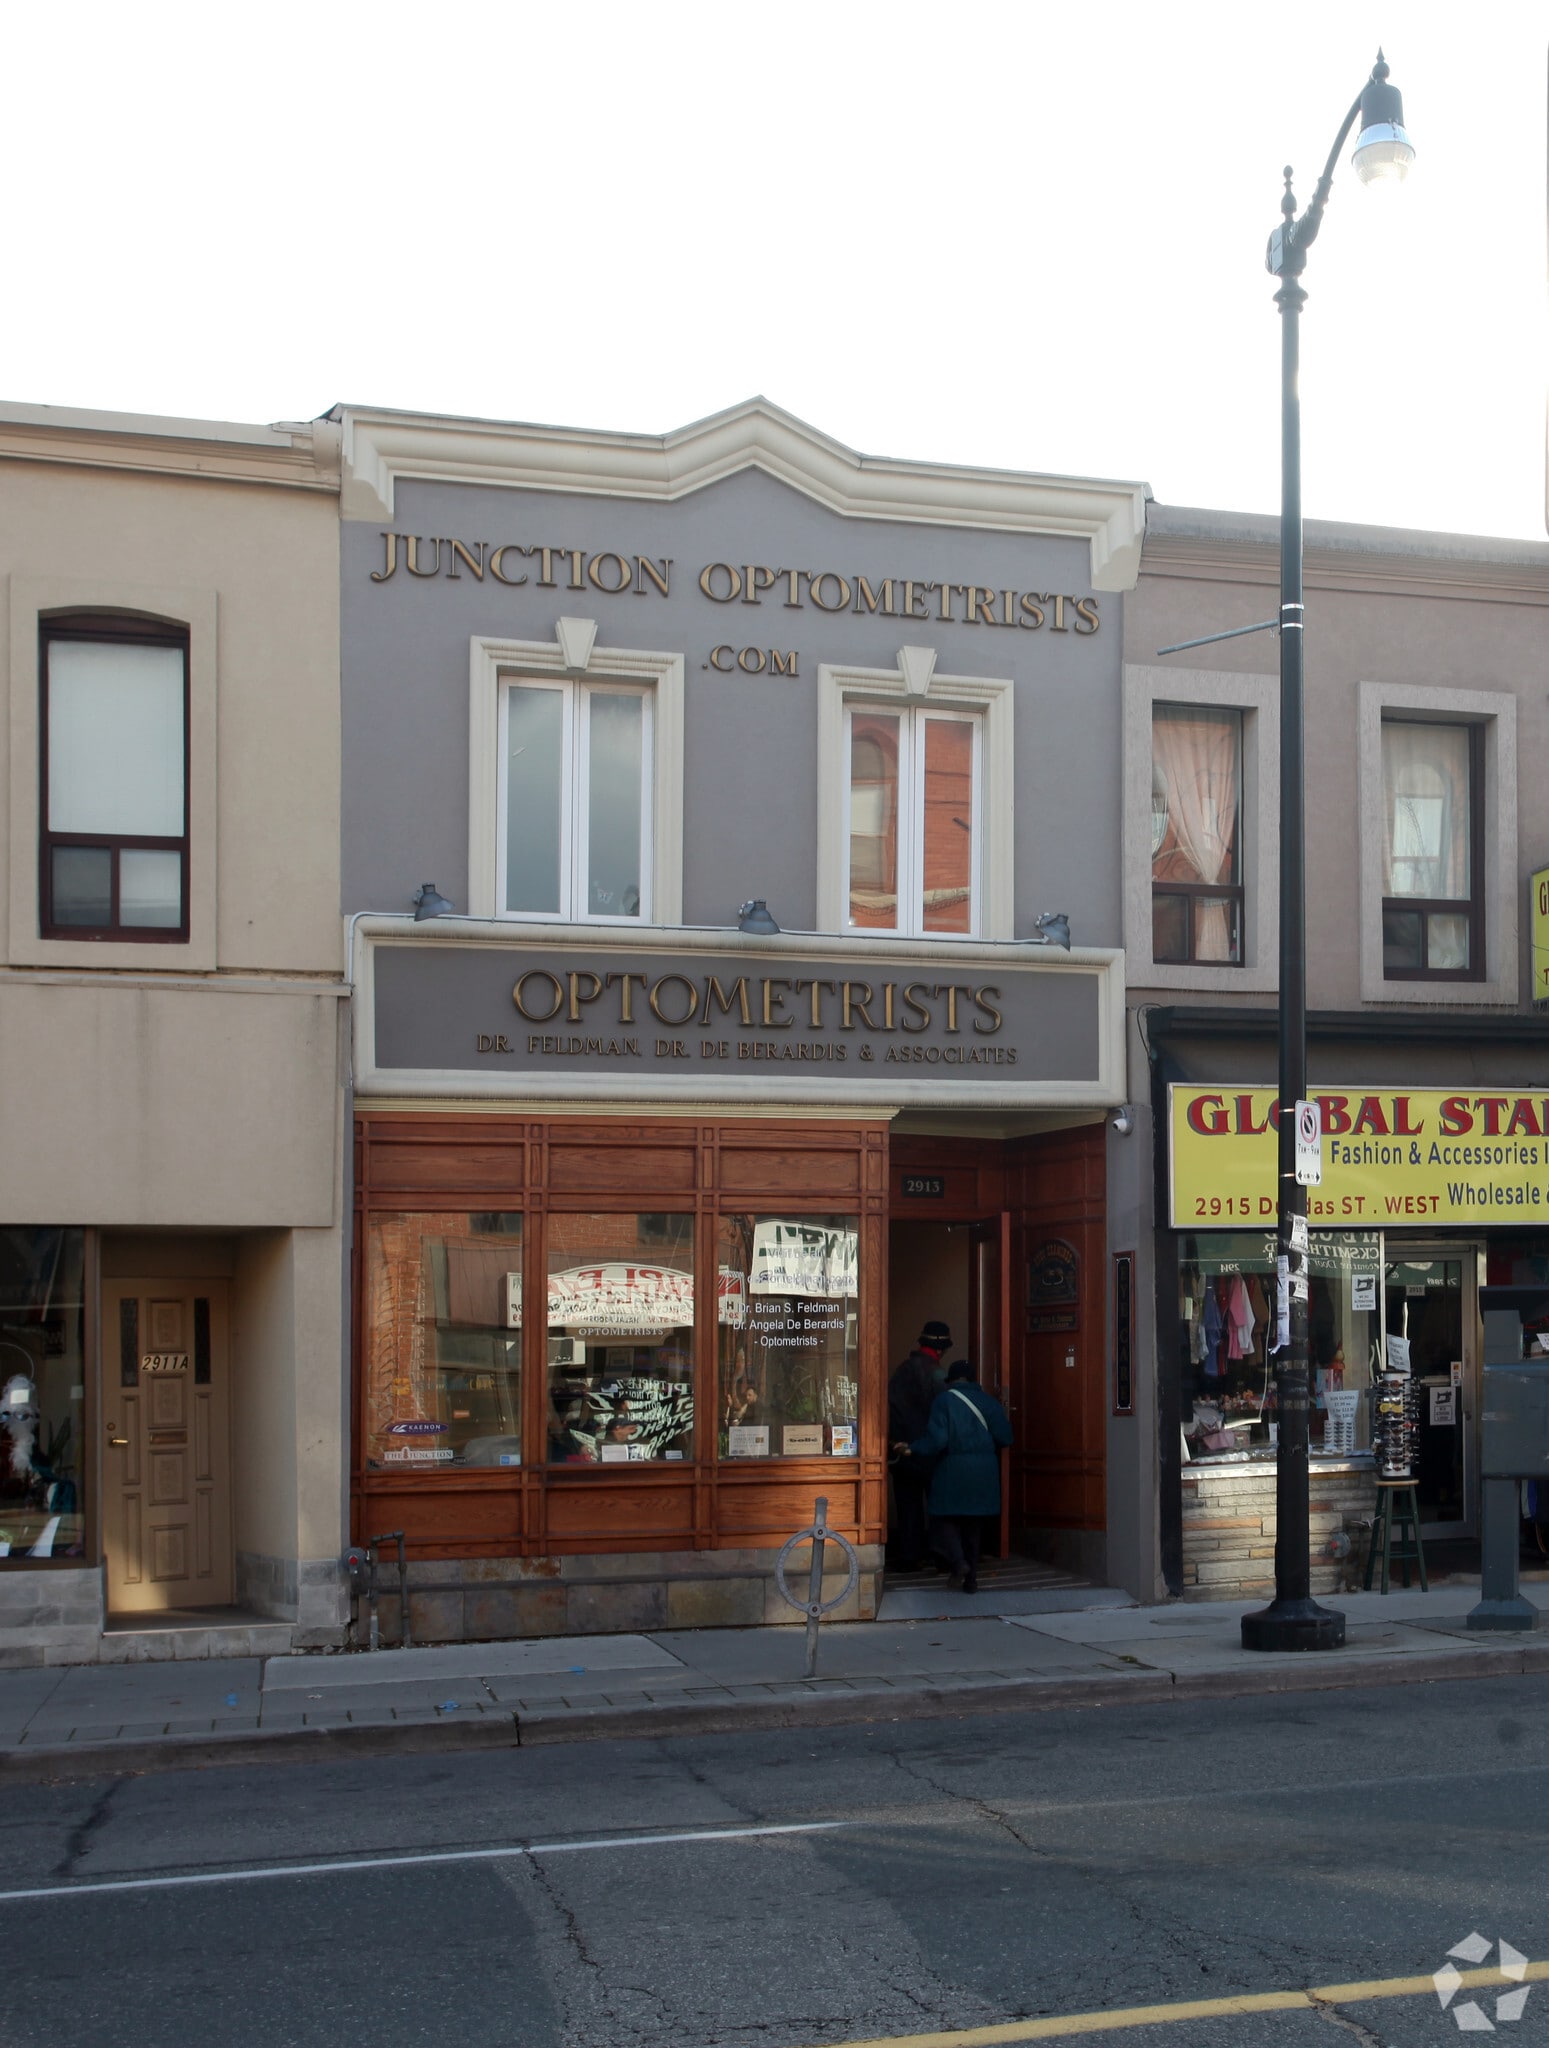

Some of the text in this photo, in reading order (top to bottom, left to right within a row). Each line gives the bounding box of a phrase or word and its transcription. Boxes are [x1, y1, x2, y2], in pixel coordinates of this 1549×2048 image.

[369, 532, 1101, 635] JUNCTION OPTOMETRISTS
[701, 644, 800, 677] .COM
[512, 968, 1002, 1035] OPTOMETRISTS
[476, 1033, 515, 1053] DR.
[654, 1038, 691, 1058] DR.
[701, 1039, 729, 1059] DE
[737, 1040, 848, 1062] BERARDIS
[859, 1043, 875, 1062] &
[885, 1045, 1019, 1064] ASSOCIATES
[1331, 1140, 1402, 1165] Fashion
[1408, 1141, 1421, 1165] &
[1428, 1141, 1539, 1165] Accessories
[906, 1179, 940, 1193] 2913
[1447, 1182, 1541, 1206] Wholesale
[1195, 1197, 1251, 1216] 2915
[1259, 1196, 1335, 1216] Ddas
[1384, 1195, 1440, 1214] WEST
[737, 1303, 752, 1313] Dr.
[755, 1302, 781, 1313] Brian
[783, 1303, 794, 1313] S.
[797, 1302, 840, 1313] Feldman
[578, 1327, 664, 1336] OPTOMETRISTS
[732, 1319, 845, 1332] Dr. Angela De Berardis
[760, 1335, 818, 1349] Optometrists
[142, 1356, 189, 1371] 2911A
[409, 1450, 453, 1460] JUNCTION
